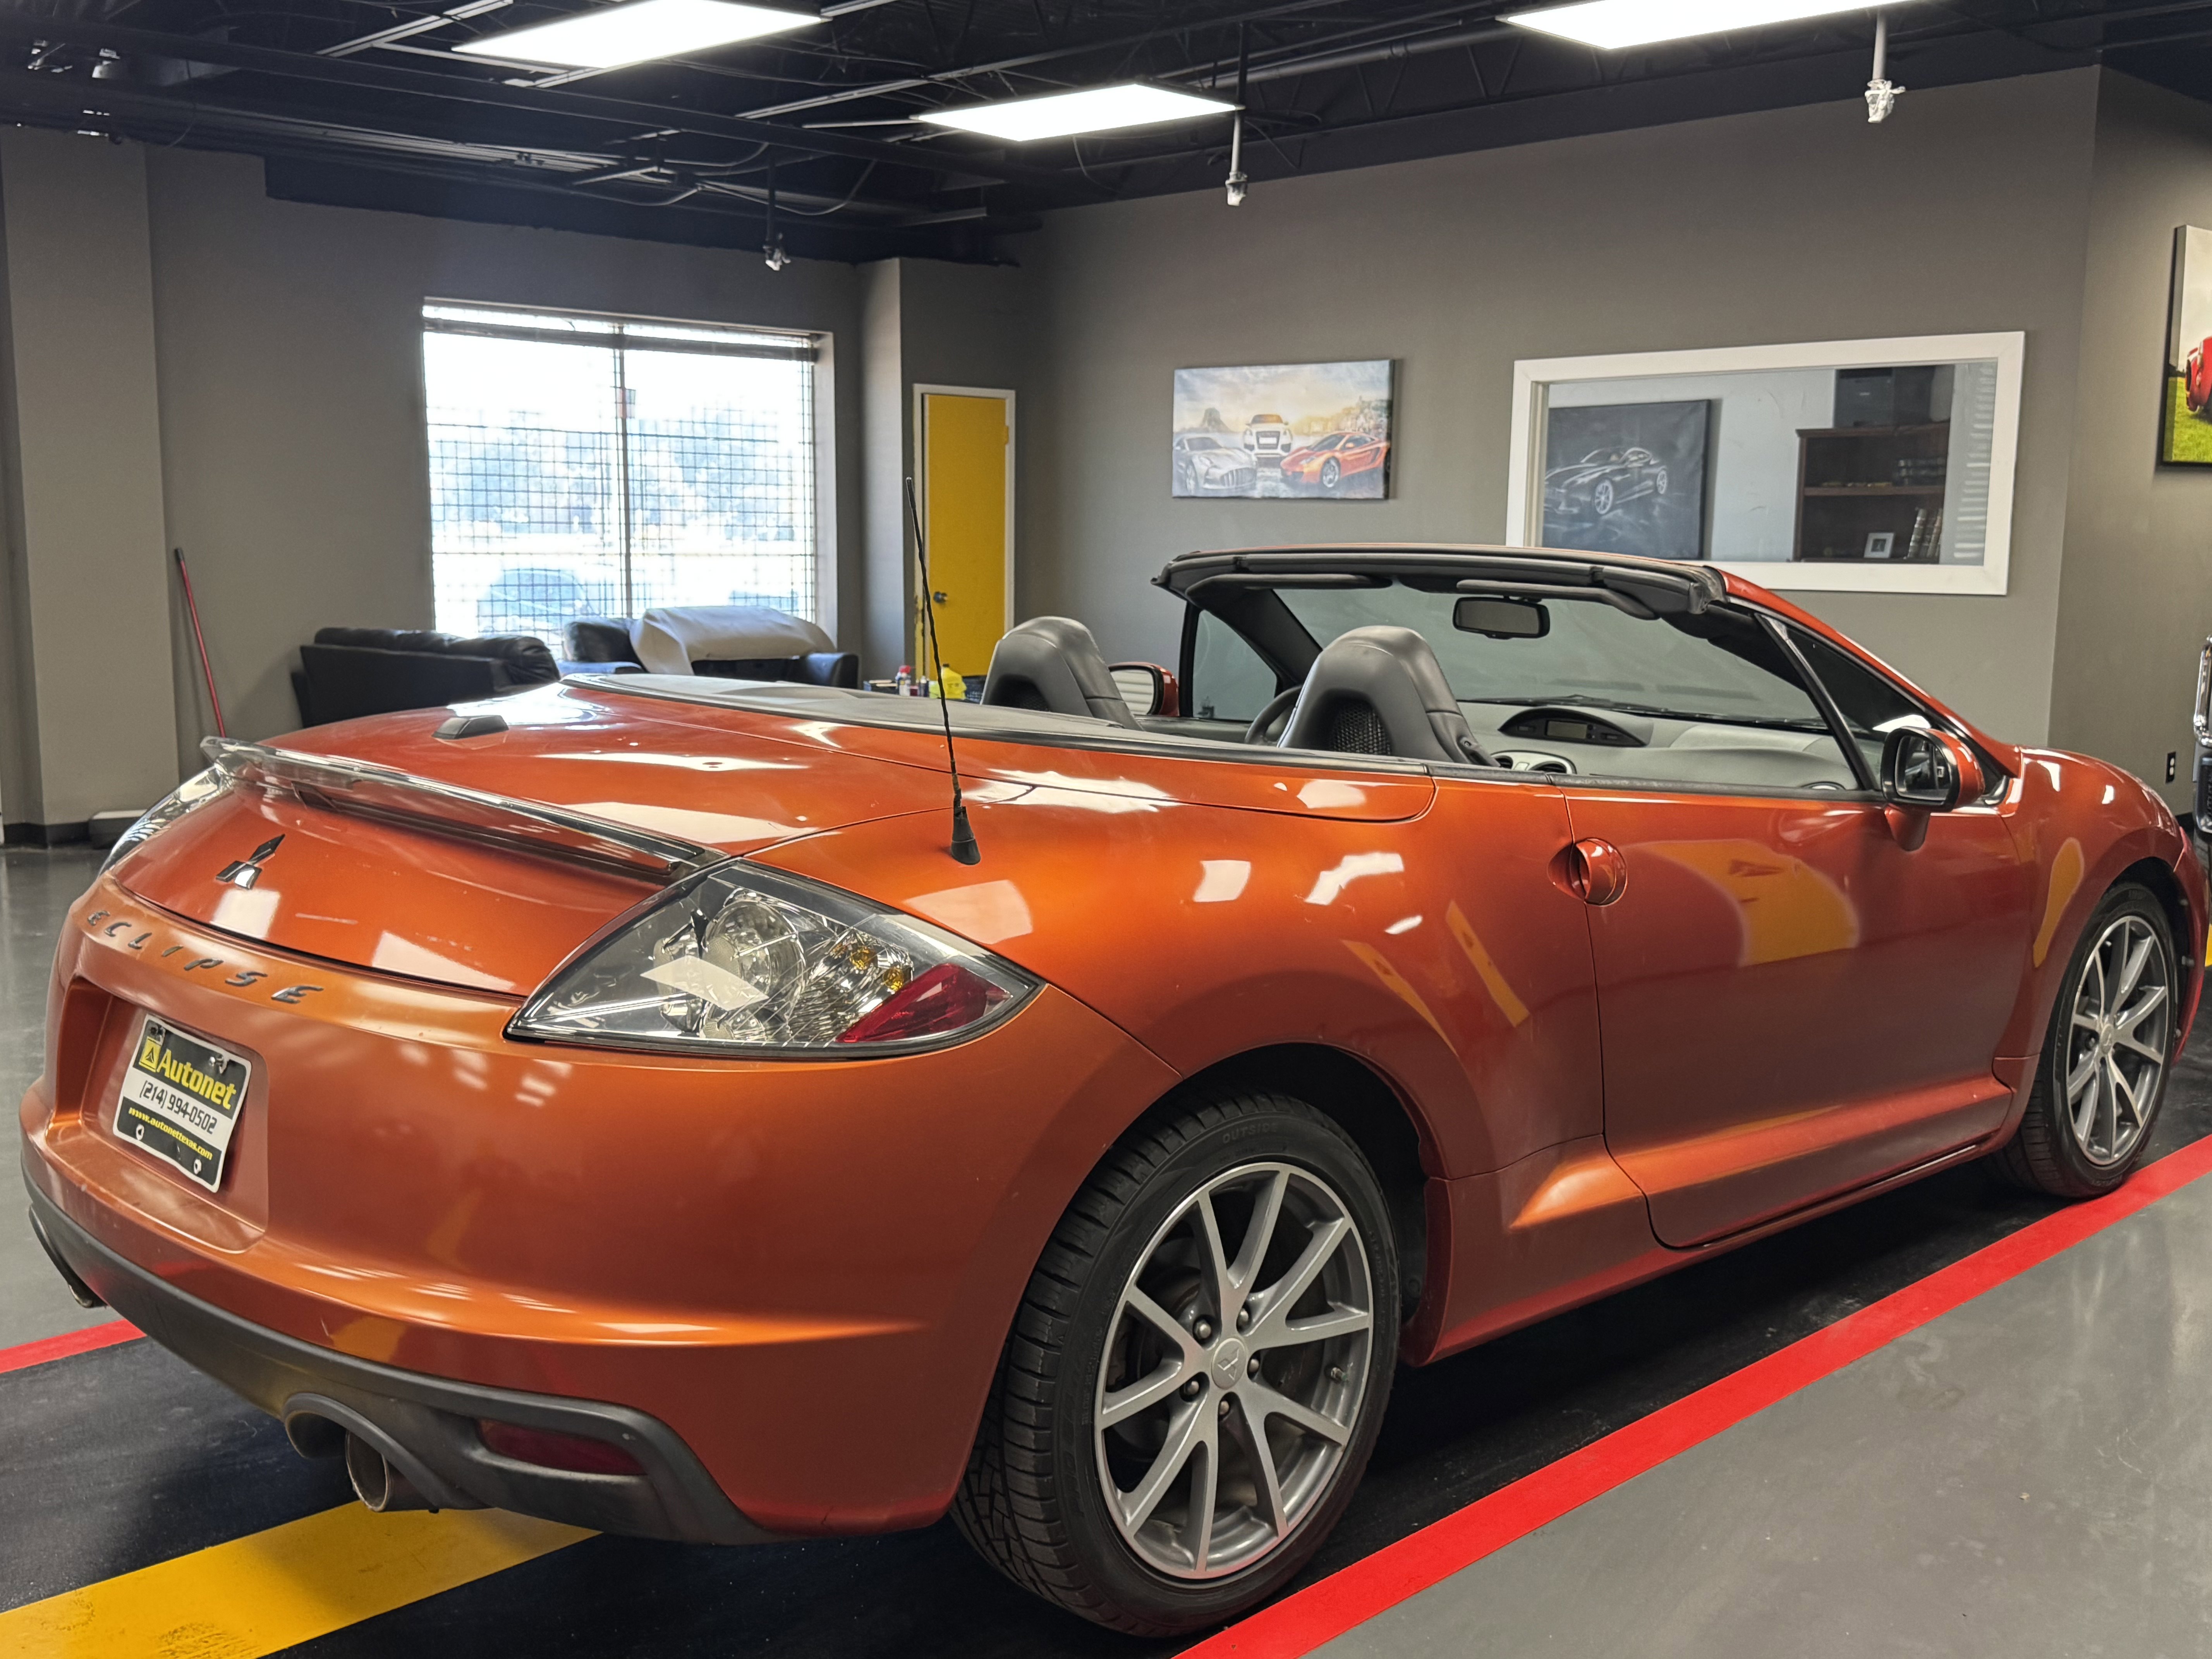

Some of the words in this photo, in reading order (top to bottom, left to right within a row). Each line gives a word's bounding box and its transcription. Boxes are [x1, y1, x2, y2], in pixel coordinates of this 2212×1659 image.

[88, 910, 324, 1004] ECLIPSE
[139, 1080, 168, 1108] (214)
[167, 1094, 217, 1135] 994-0502
[156, 1048, 236, 1110] Autonet
[129, 1107, 213, 1160] www.autonettexas.com
